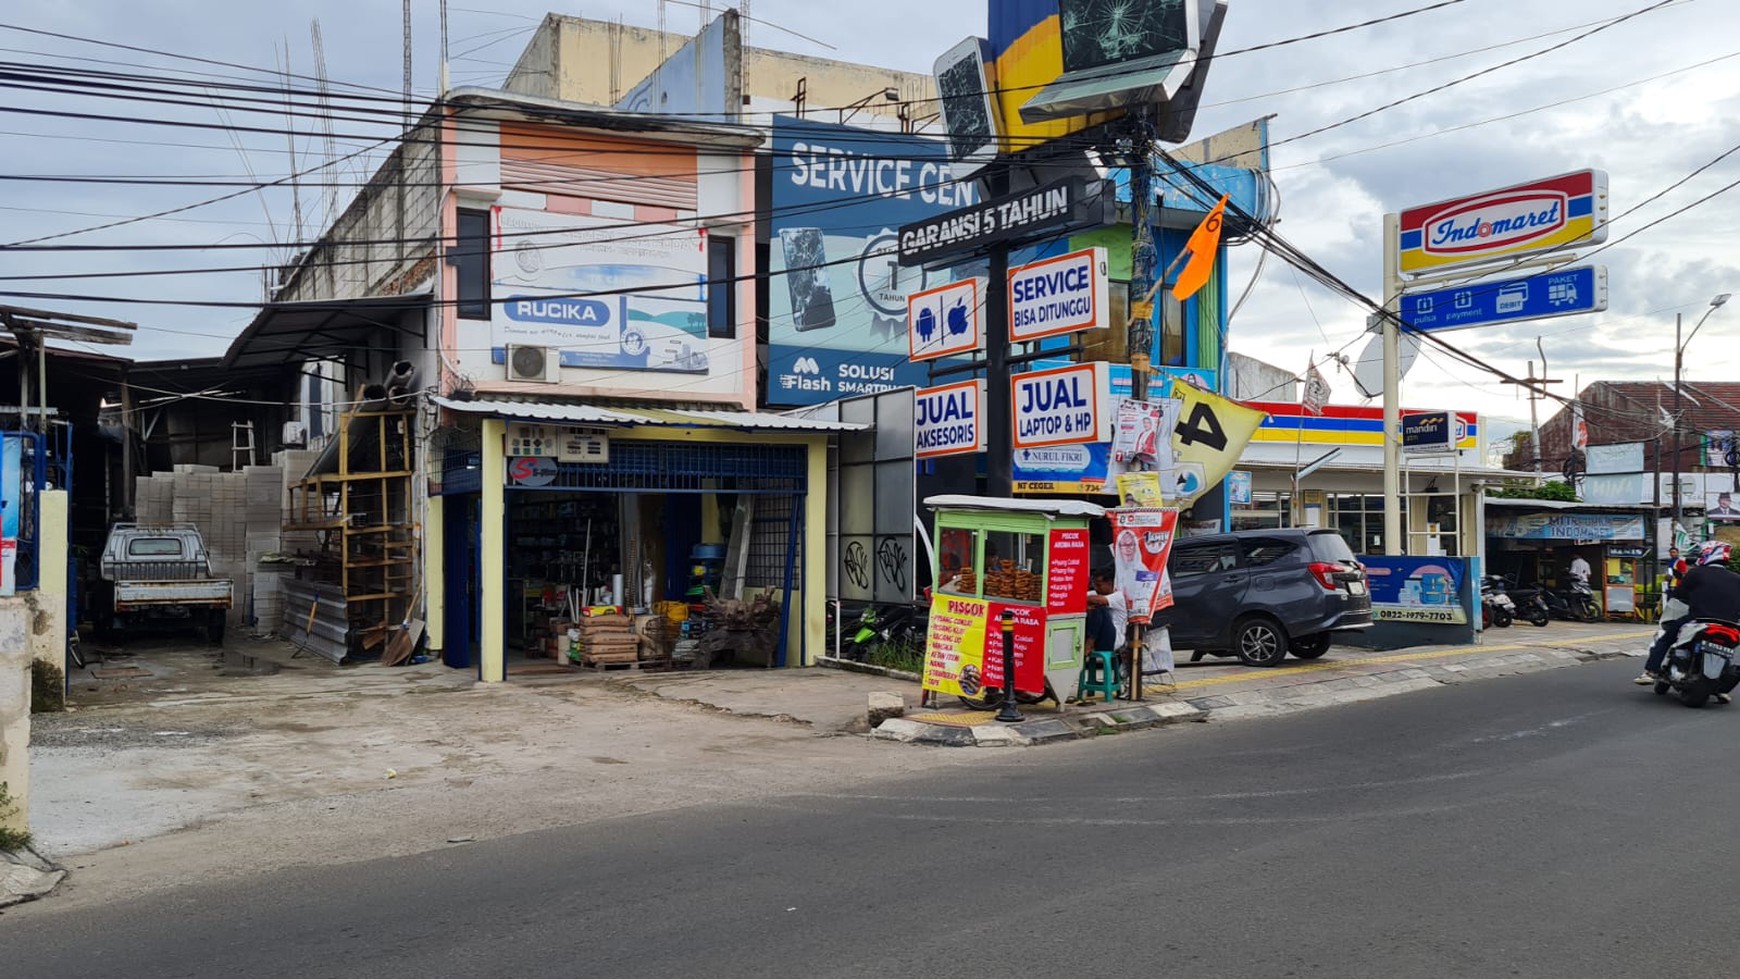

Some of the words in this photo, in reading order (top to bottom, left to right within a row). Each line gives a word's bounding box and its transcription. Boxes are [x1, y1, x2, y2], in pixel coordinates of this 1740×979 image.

[791, 141, 911, 200] SERVICE
[919, 162, 982, 207] CEN
[901, 212, 981, 256] GARANSI
[984, 210, 995, 235] 5
[997, 186, 1068, 230] TAHUN
[1205, 211, 1222, 232] 6
[1431, 200, 1559, 245] Indomaret
[1013, 265, 1089, 304] SERVICE
[1548, 273, 1579, 285] PAKET
[517, 301, 598, 321] RUCIKA
[1013, 309, 1037, 328] BISA
[1038, 296, 1091, 324] DITUNGGU
[1446, 307, 1483, 323] payment
[1500, 300, 1522, 310] DEBIT
[1413, 314, 1437, 325] pulsa
[780, 374, 831, 392] Flash
[838, 363, 895, 382] SOLUSI
[1021, 377, 1087, 413] JUAL
[916, 392, 973, 426] JUAL
[1019, 416, 1062, 437] LAPTOP
[1065, 413, 1073, 432] &
[1075, 412, 1092, 432] HP
[1174, 401, 1228, 451] 4
[916, 424, 974, 449] AKSESORIS
[1032, 451, 1060, 461] NURUL
[1061, 452, 1082, 462] FIKRI
[948, 600, 986, 617] PISCOK
[1380, 610, 1453, 621] 0822-1979-7703
